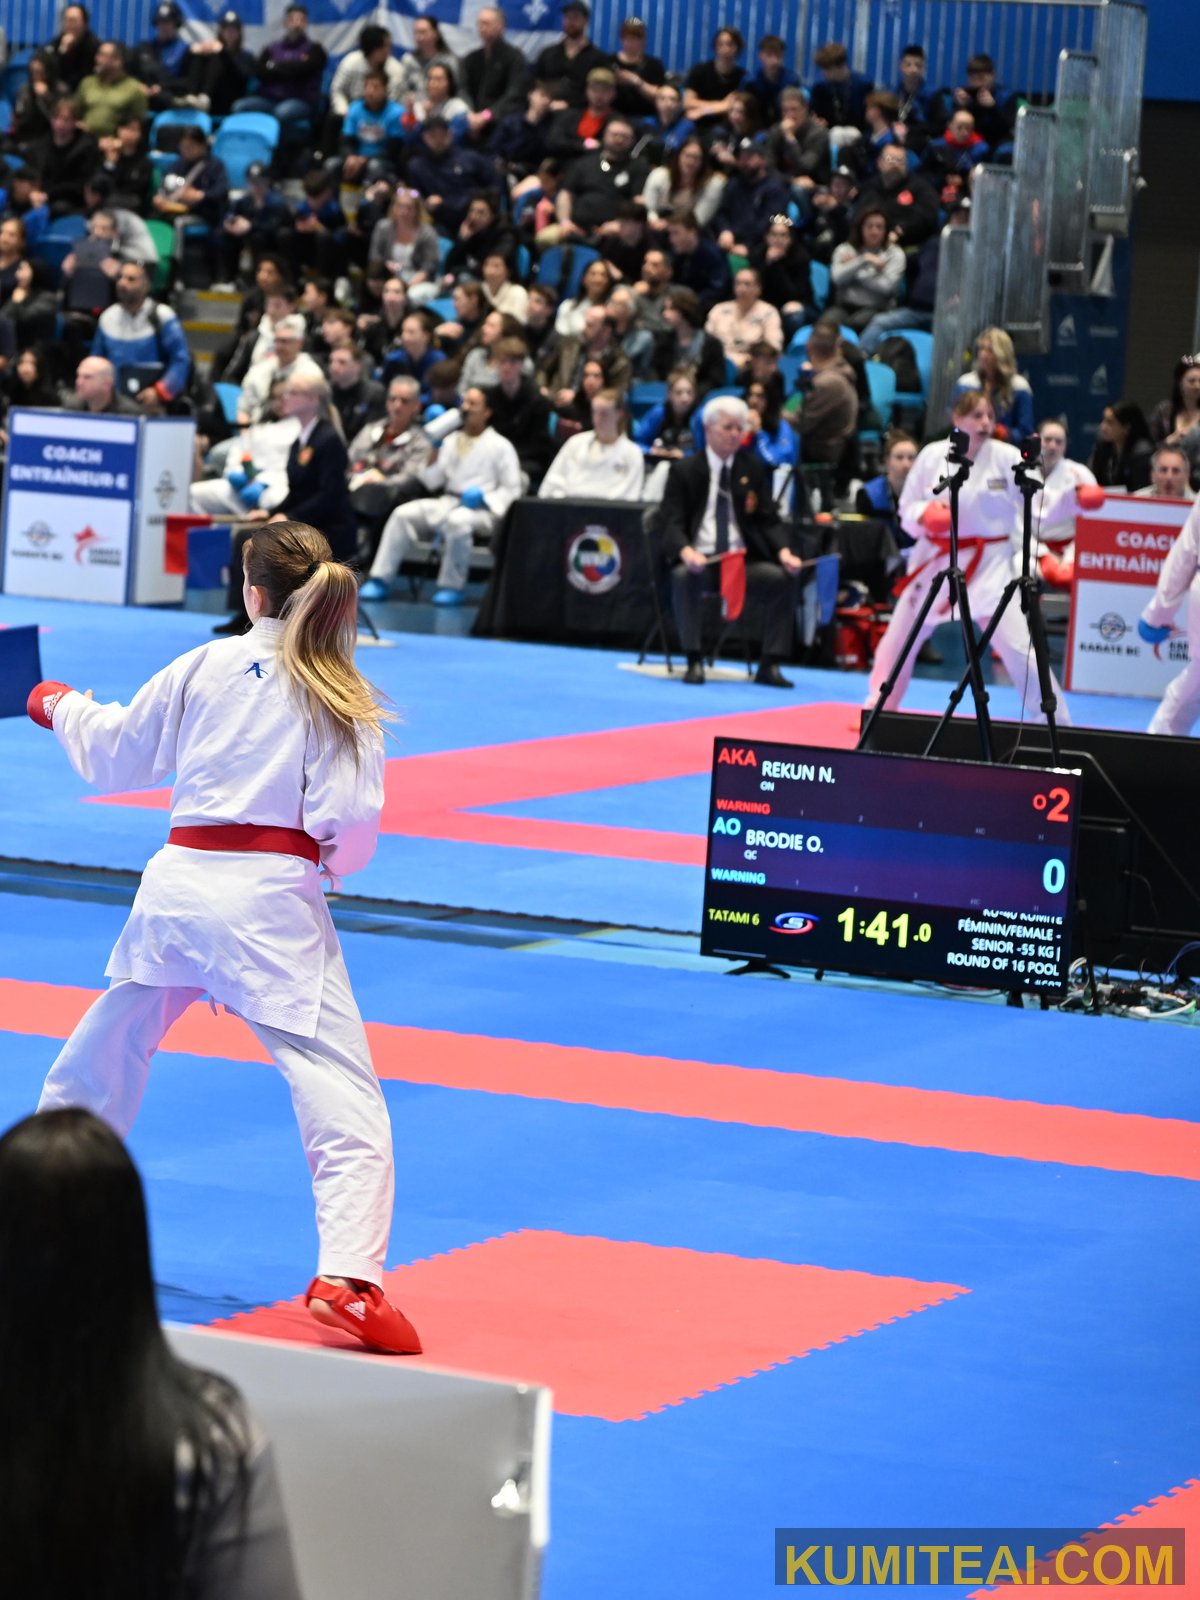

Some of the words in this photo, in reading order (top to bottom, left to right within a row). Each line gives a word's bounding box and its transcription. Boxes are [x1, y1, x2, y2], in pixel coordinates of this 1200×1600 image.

[42, 445, 103, 464] COACH
[717, 747, 757, 767] AKA
[762, 760, 814, 781] REKUN
[818, 767, 836, 784] N.
[760, 781, 775, 792] ON
[716, 799, 771, 815] WARNING
[712, 816, 741, 836] AO
[745, 829, 803, 850] BRODIE
[806, 836, 824, 853] O.
[743, 850, 757, 860] QC
[711, 868, 766, 885] WARNING
[1042, 858, 1066, 894] 0
[708, 908, 750, 924] TATAMI
[751, 914, 760, 926] 6
[958, 917, 1054, 941] FÉMININ/FEMALE
[971, 938, 1014, 954] SENIOR
[1016, 943, 1035, 956] -55
[1037, 945, 1054, 959] KG
[947, 952, 990, 969] ROUND
[992, 957, 1009, 970] OF
[1012, 959, 1025, 973] 16
[1027, 961, 1059, 976] POOL
